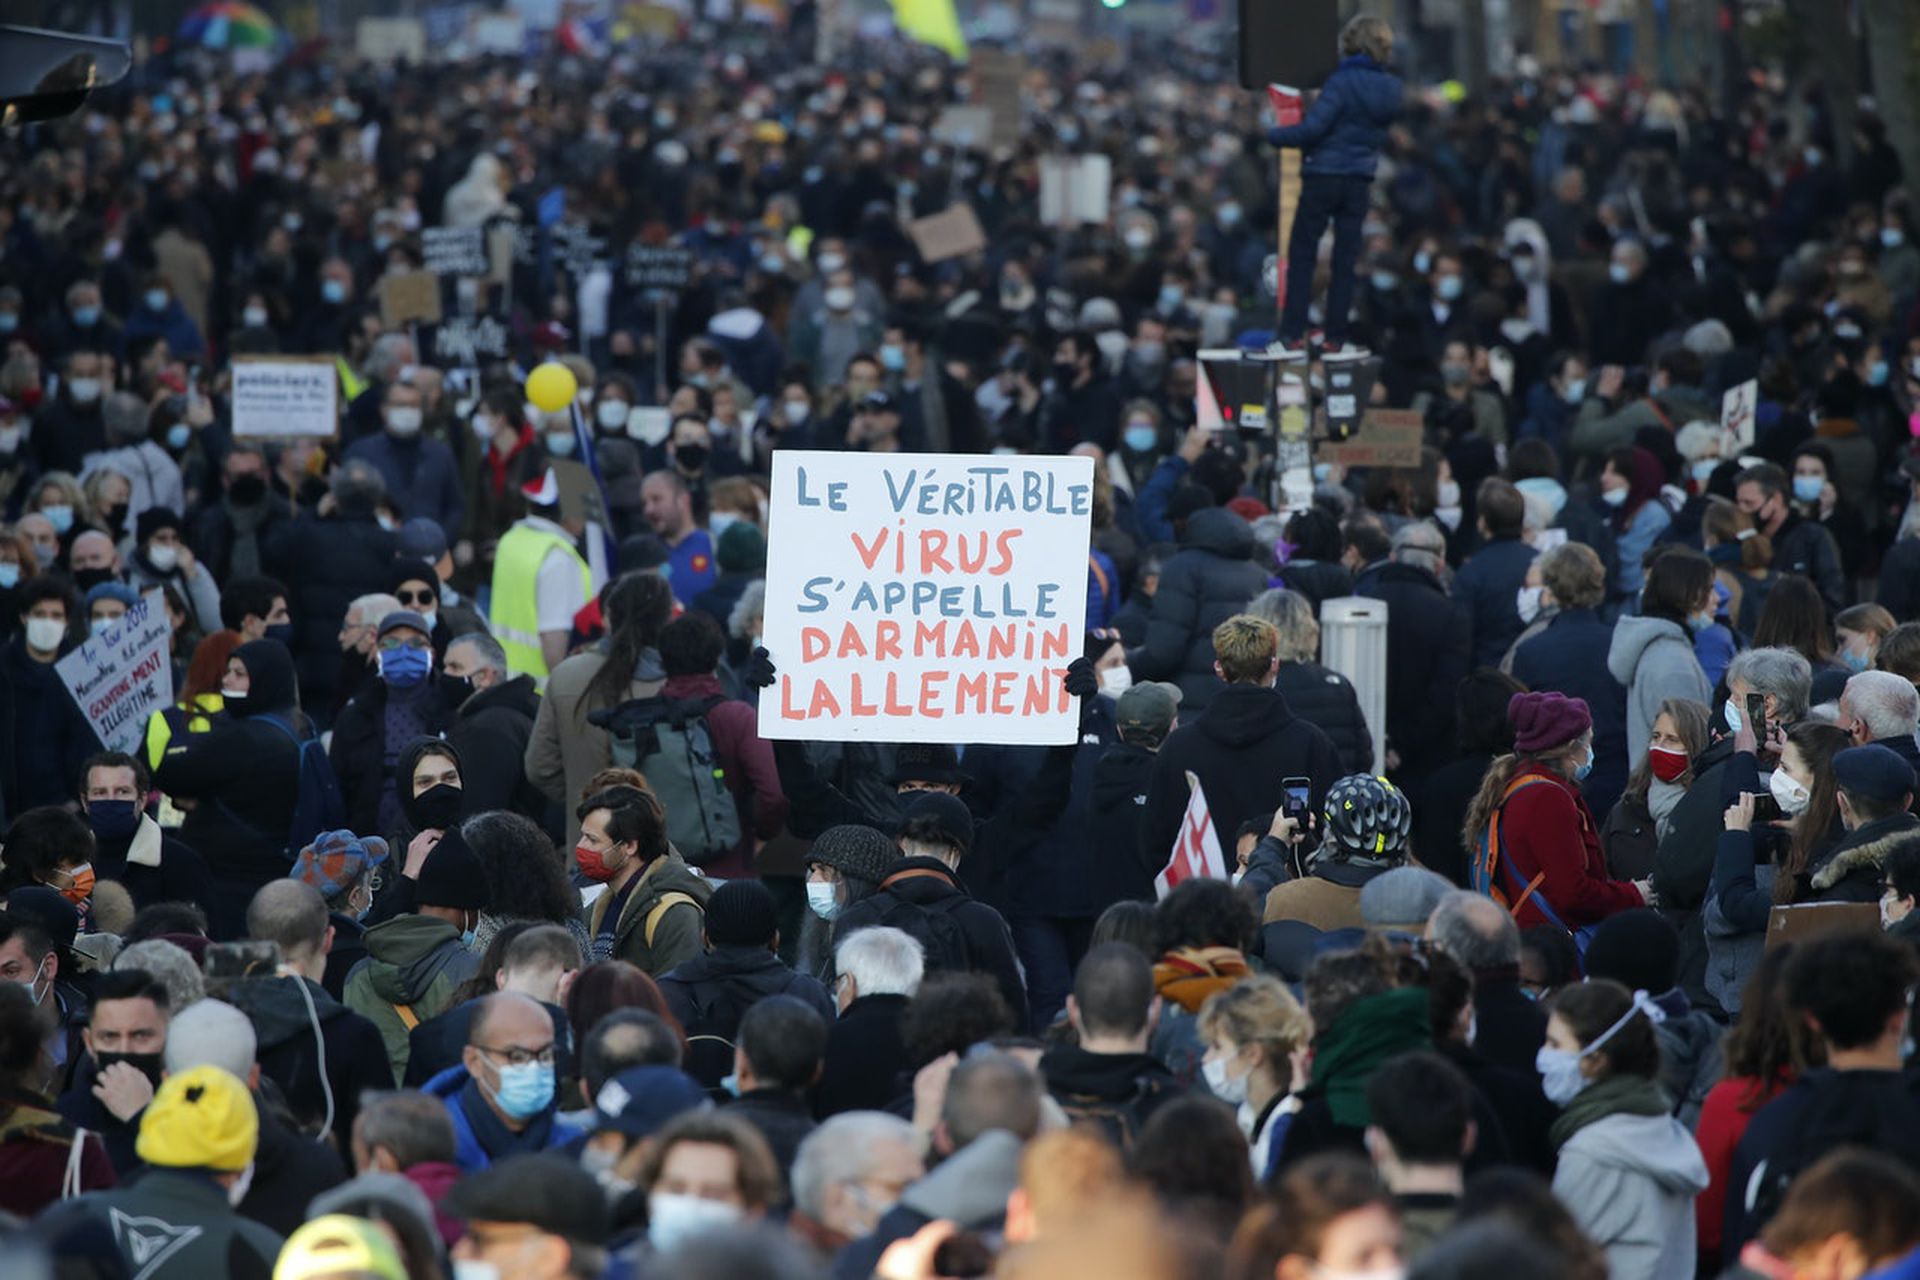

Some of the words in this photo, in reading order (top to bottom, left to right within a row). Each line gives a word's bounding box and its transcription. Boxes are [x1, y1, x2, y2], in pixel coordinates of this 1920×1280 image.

[798, 467, 848, 511] LE
[797, 577, 1060, 618] S'APPELLE
[781, 666, 1071, 720] LALLEMENT
